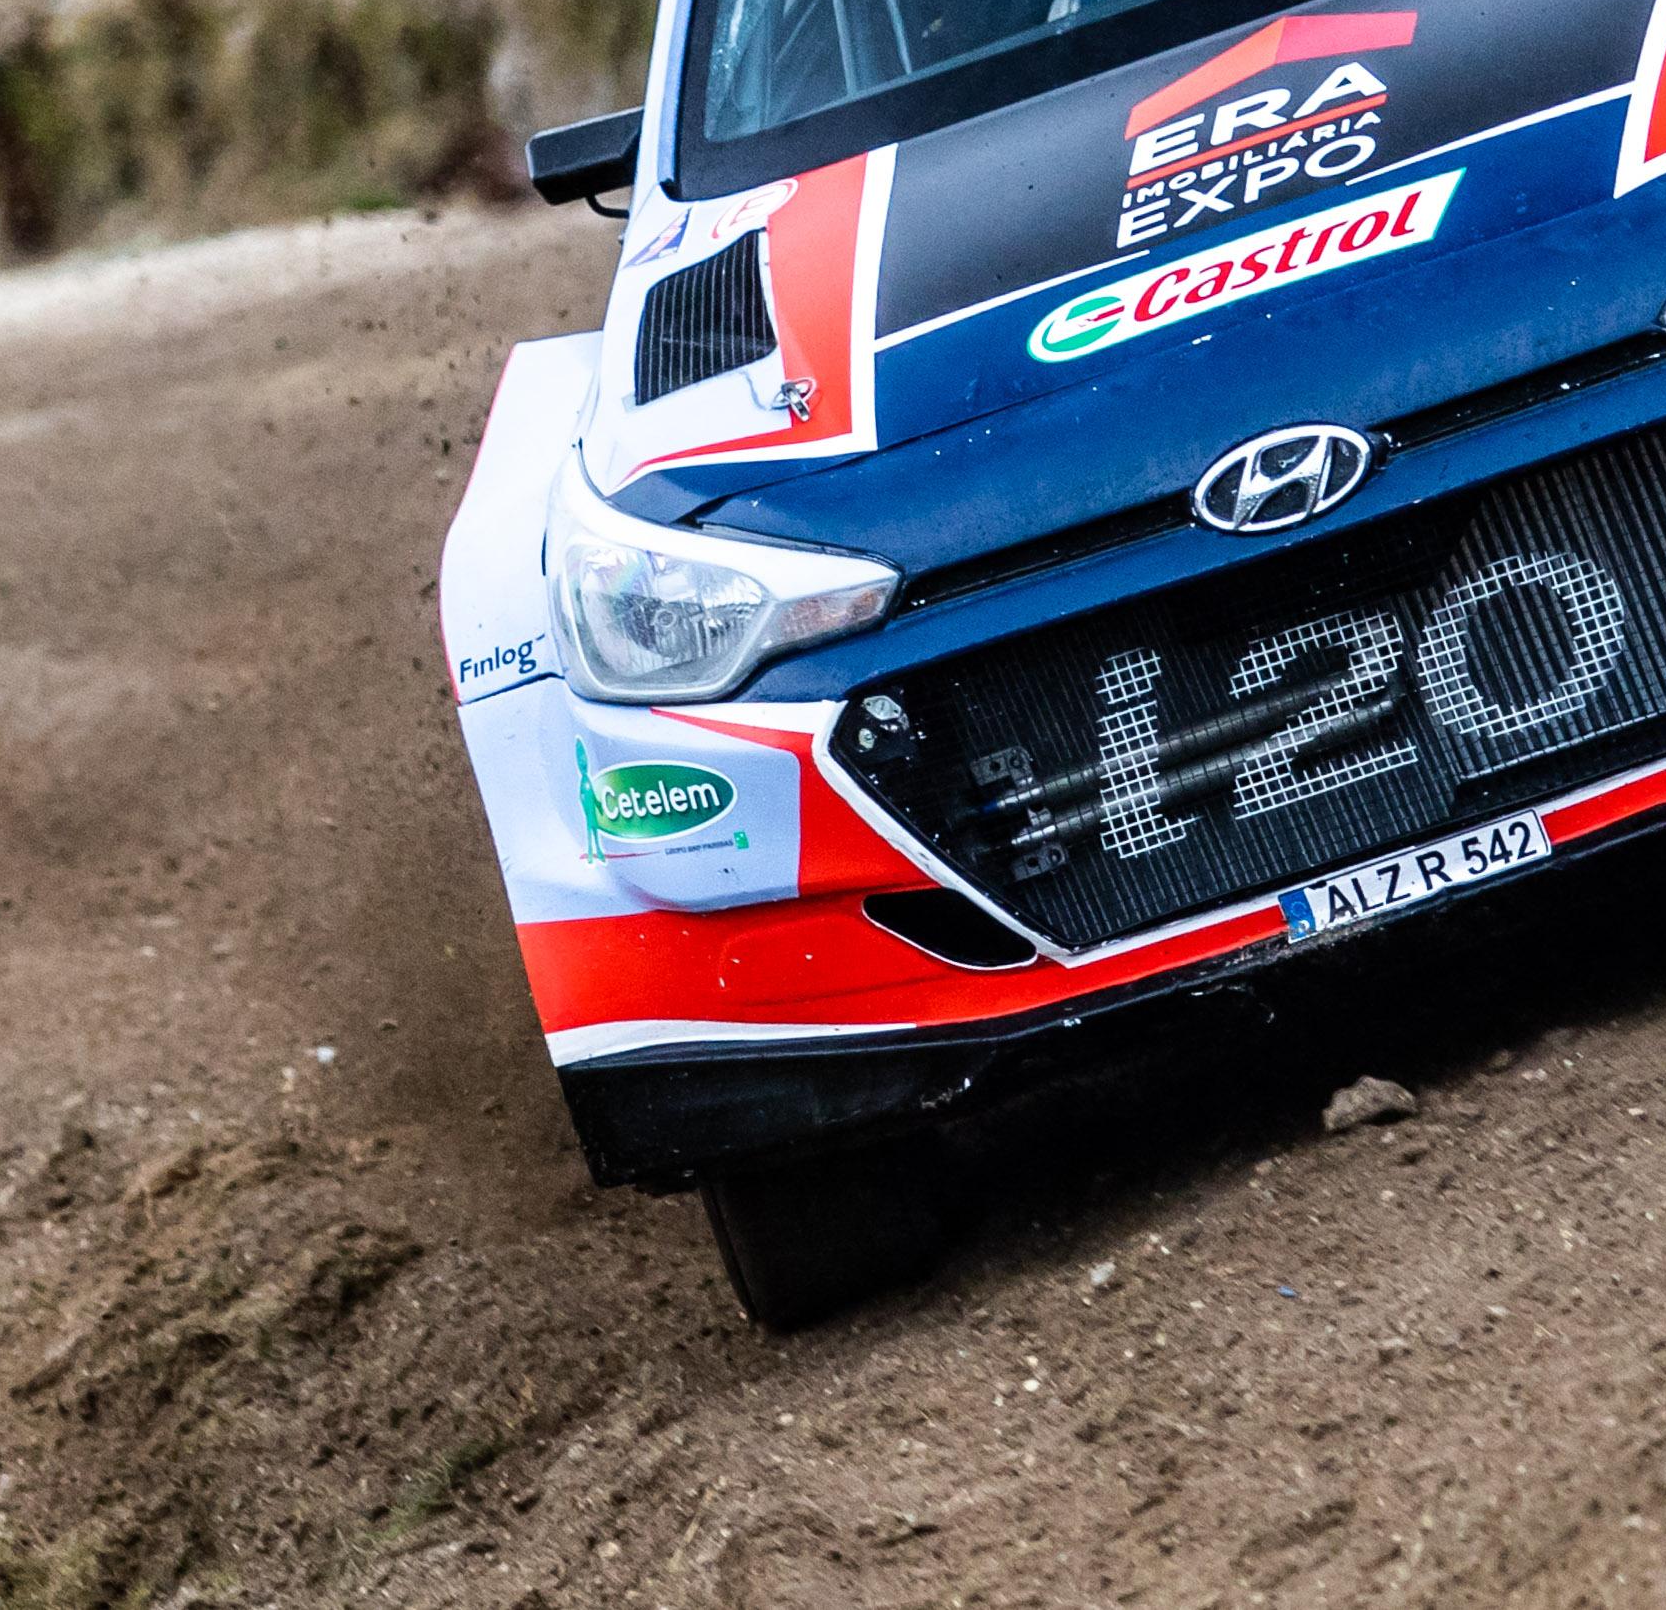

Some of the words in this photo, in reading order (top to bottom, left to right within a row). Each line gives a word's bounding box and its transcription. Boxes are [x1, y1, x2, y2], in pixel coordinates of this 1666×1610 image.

[1121, 111, 1382, 209] IMOBILIÁRIA
[1128, 61, 1388, 177] ERA
[1115, 135, 1377, 249] EXPO
[1133, 190, 1423, 324] Castrol
[459, 639, 538, 684] Finlog
[600, 779, 721, 821] Cetelem
[1328, 862, 1411, 923] ALZ
[1415, 849, 1453, 891] R
[1460, 820, 1538, 876] 542
